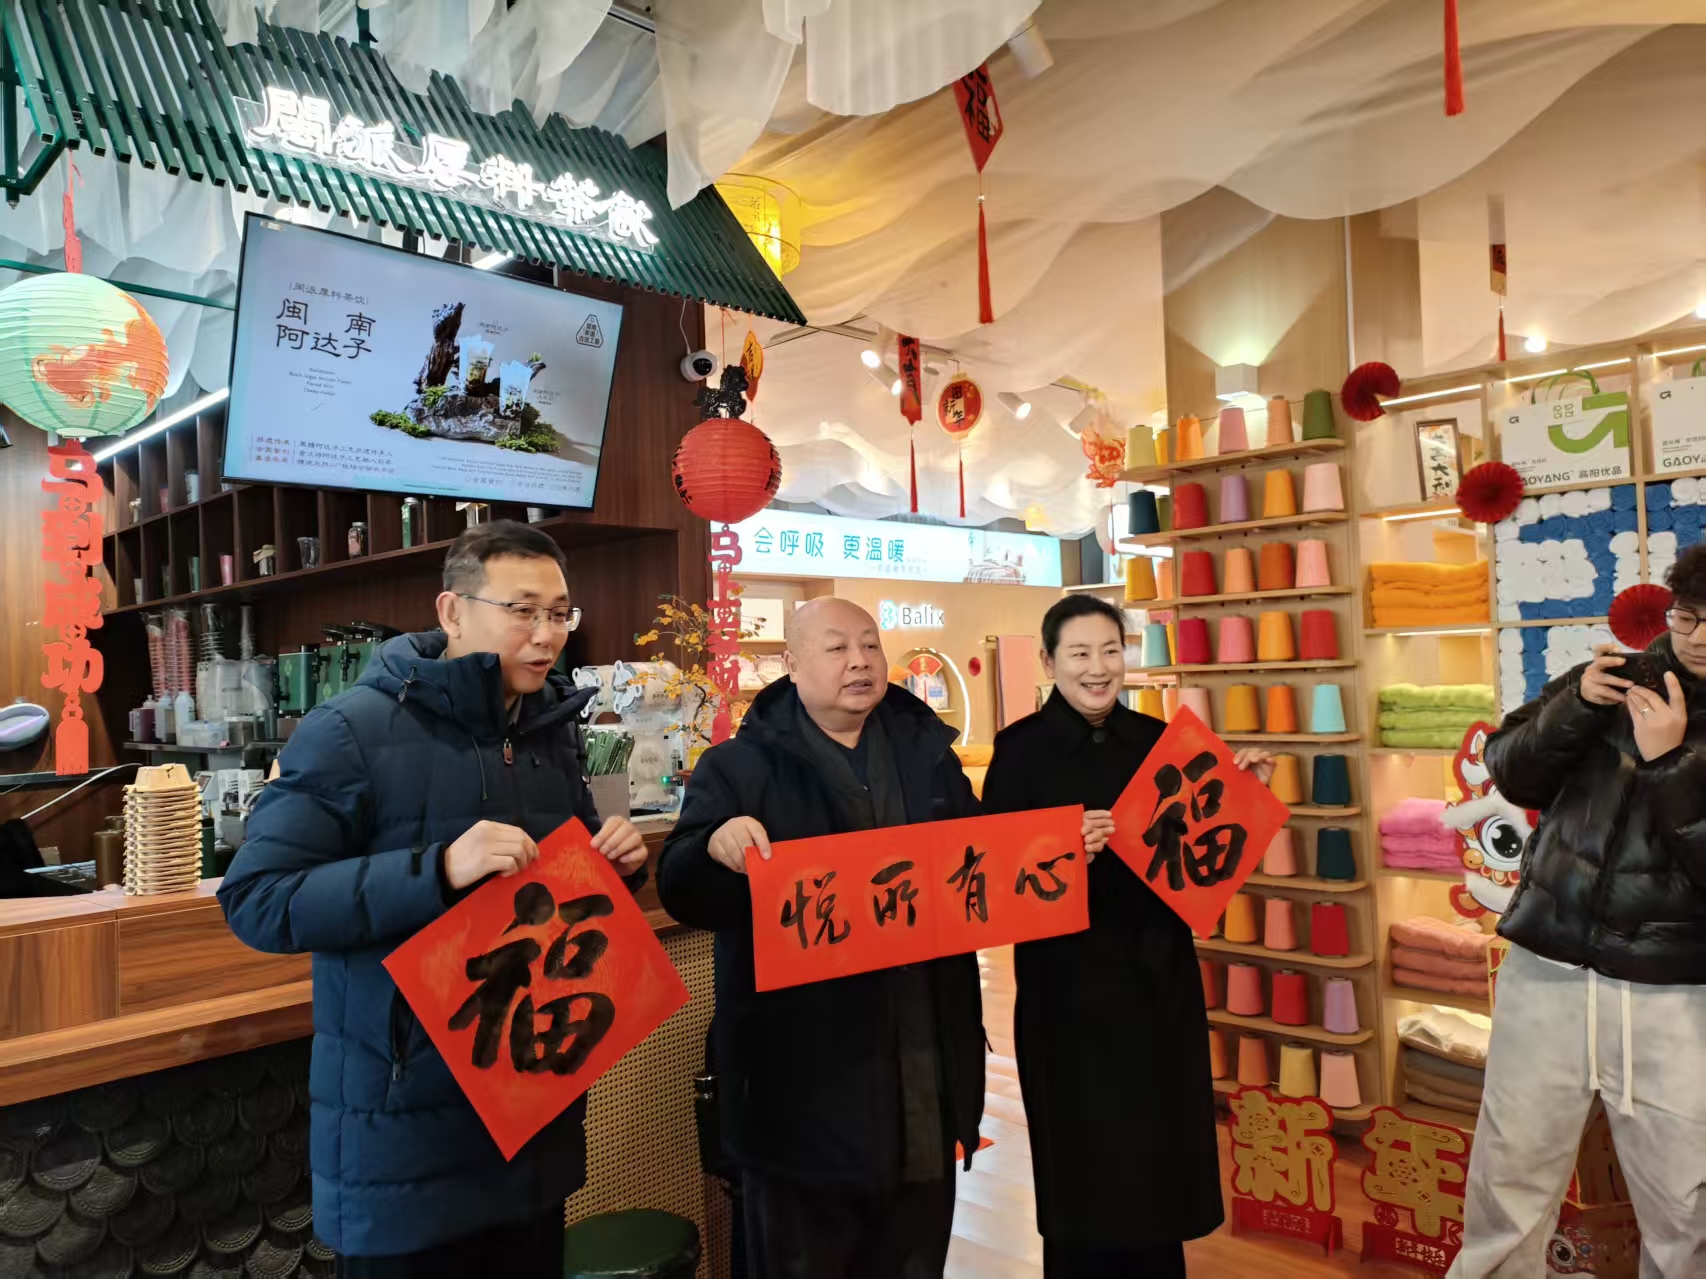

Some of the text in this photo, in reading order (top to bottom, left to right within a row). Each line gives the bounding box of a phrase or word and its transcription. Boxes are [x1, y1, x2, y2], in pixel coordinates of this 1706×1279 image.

[276, 298, 376, 337] 闽 南
[276, 324, 372, 359] 阿达子
[1520, 471, 1571, 486] AOYANG
[1579, 465, 1623, 479] 高阳优品
[754, 526, 905, 562] 会呼吸 更温暖
[902, 605, 945, 625] Balix
[1143, 750, 1248, 893] 福
[448, 881, 616, 1076] 福
[1229, 1085, 1338, 1213] 新
[1362, 1105, 1471, 1238] 年
